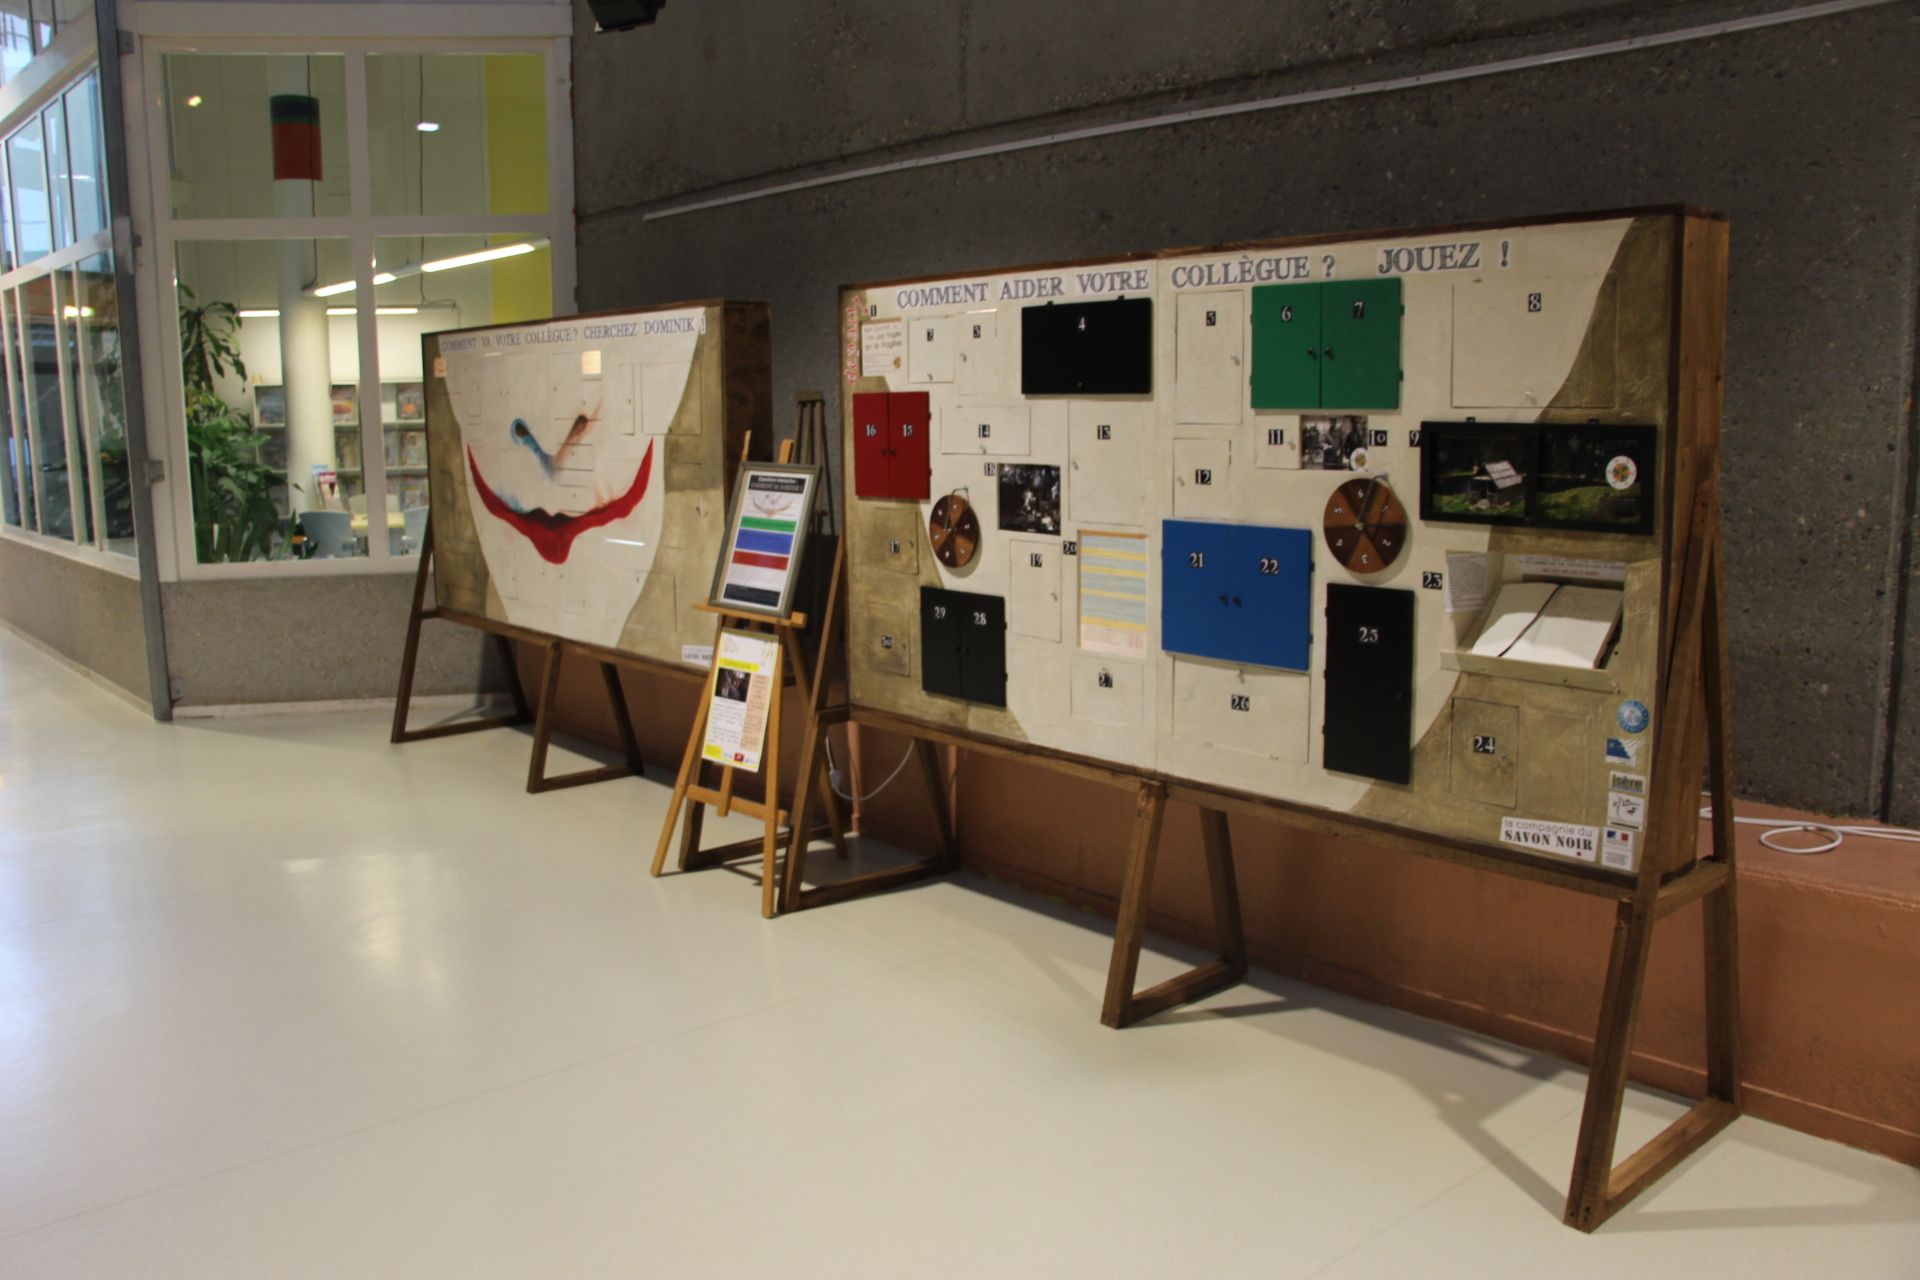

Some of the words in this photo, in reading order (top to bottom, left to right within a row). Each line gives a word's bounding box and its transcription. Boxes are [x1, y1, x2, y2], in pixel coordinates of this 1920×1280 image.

[897, 283, 989, 308] COMMENT
[1000, 277, 1064, 300] AIDER
[1077, 270, 1149, 293] VOTRE
[1171, 256, 1310, 288] COLLÈGUE
[1322, 254, 1335, 278] ?
[1378, 243, 1481, 274] JOUEZ
[1500, 241, 1508, 267] !
[1354, 301, 1365, 318] 7
[1530, 294, 1541, 311] 8
[1282, 306, 1292, 321] 6
[1078, 317, 1086, 331] 4
[441, 339, 477, 353] COMMENT
[482, 337, 491, 347] VA
[496, 332, 521, 347] VOTRE
[584, 322, 637, 339] CHERCHEZ
[644, 317, 695, 334] DOMINIK
[865, 424, 877, 437] 16
[978, 424, 990, 438] 14
[1269, 429, 1283, 444] 11
[1410, 430, 1420, 446] 9
[984, 463, 996, 476] 18
[1196, 470, 1211, 484] 12
[889, 541, 900, 554] 17
[1030, 553, 1042, 567] 19
[1190, 552, 1204, 567] 21
[1261, 558, 1279, 573] 22
[934, 606, 946, 620] 29
[974, 612, 987, 625] 28
[1099, 673, 1113, 688] 27
[1231, 695, 1250, 711] 26
[1474, 736, 1495, 753] 24
[1504, 818, 1513, 828] la
[1516, 820, 1575, 835] compagnie
[1578, 827, 1593, 837] du
[1504, 830, 1551, 846] SAVON
[1556, 835, 1593, 851] NOIR
